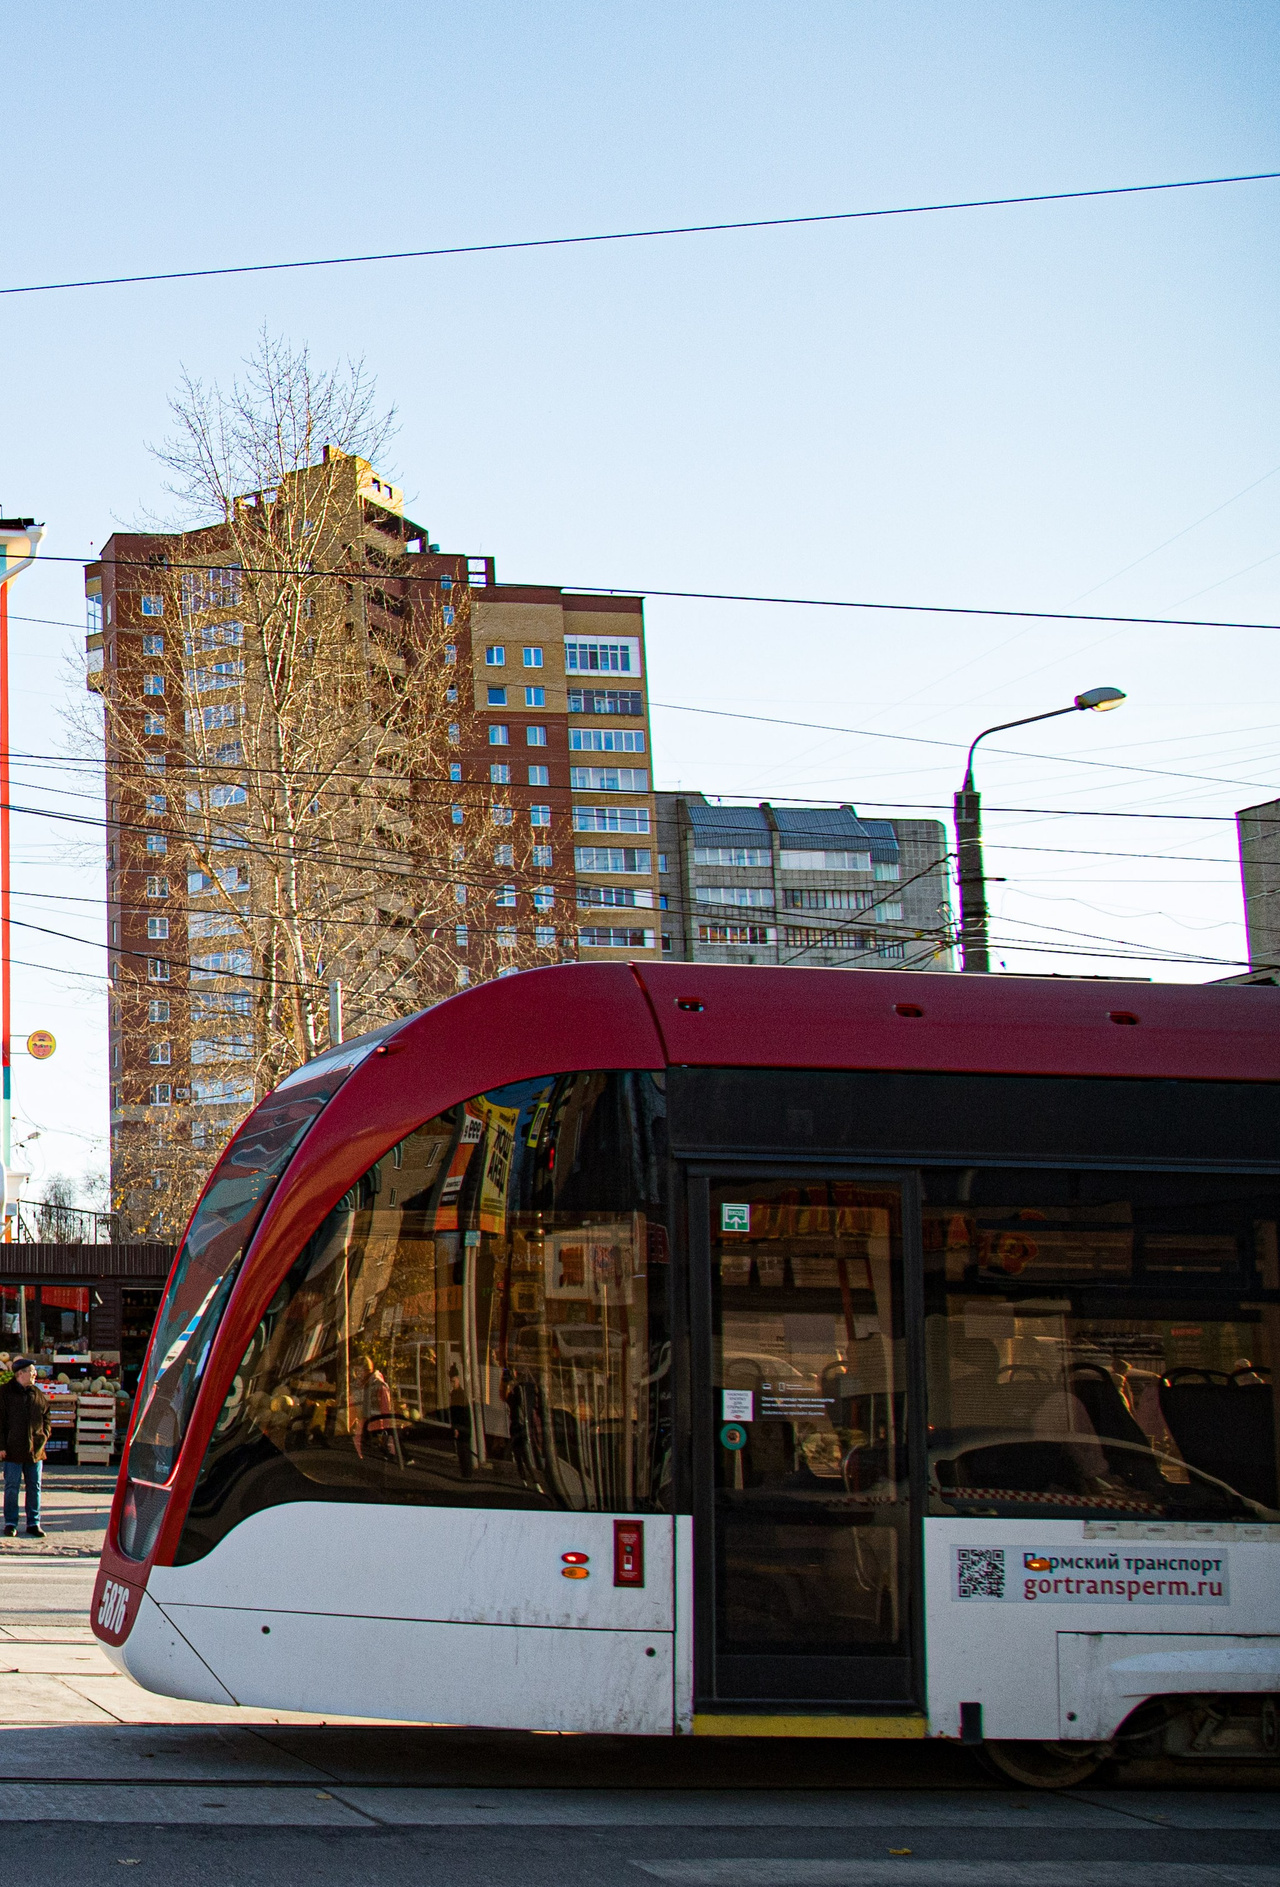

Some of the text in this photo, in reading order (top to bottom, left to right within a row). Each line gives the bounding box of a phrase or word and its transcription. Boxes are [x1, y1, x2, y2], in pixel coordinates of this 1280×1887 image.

[1023, 1552, 1222, 1576] Прмский транспорт
[1024, 1577, 1222, 1601] gortransperm.ru
[97, 1579, 130, 1635] 5876
